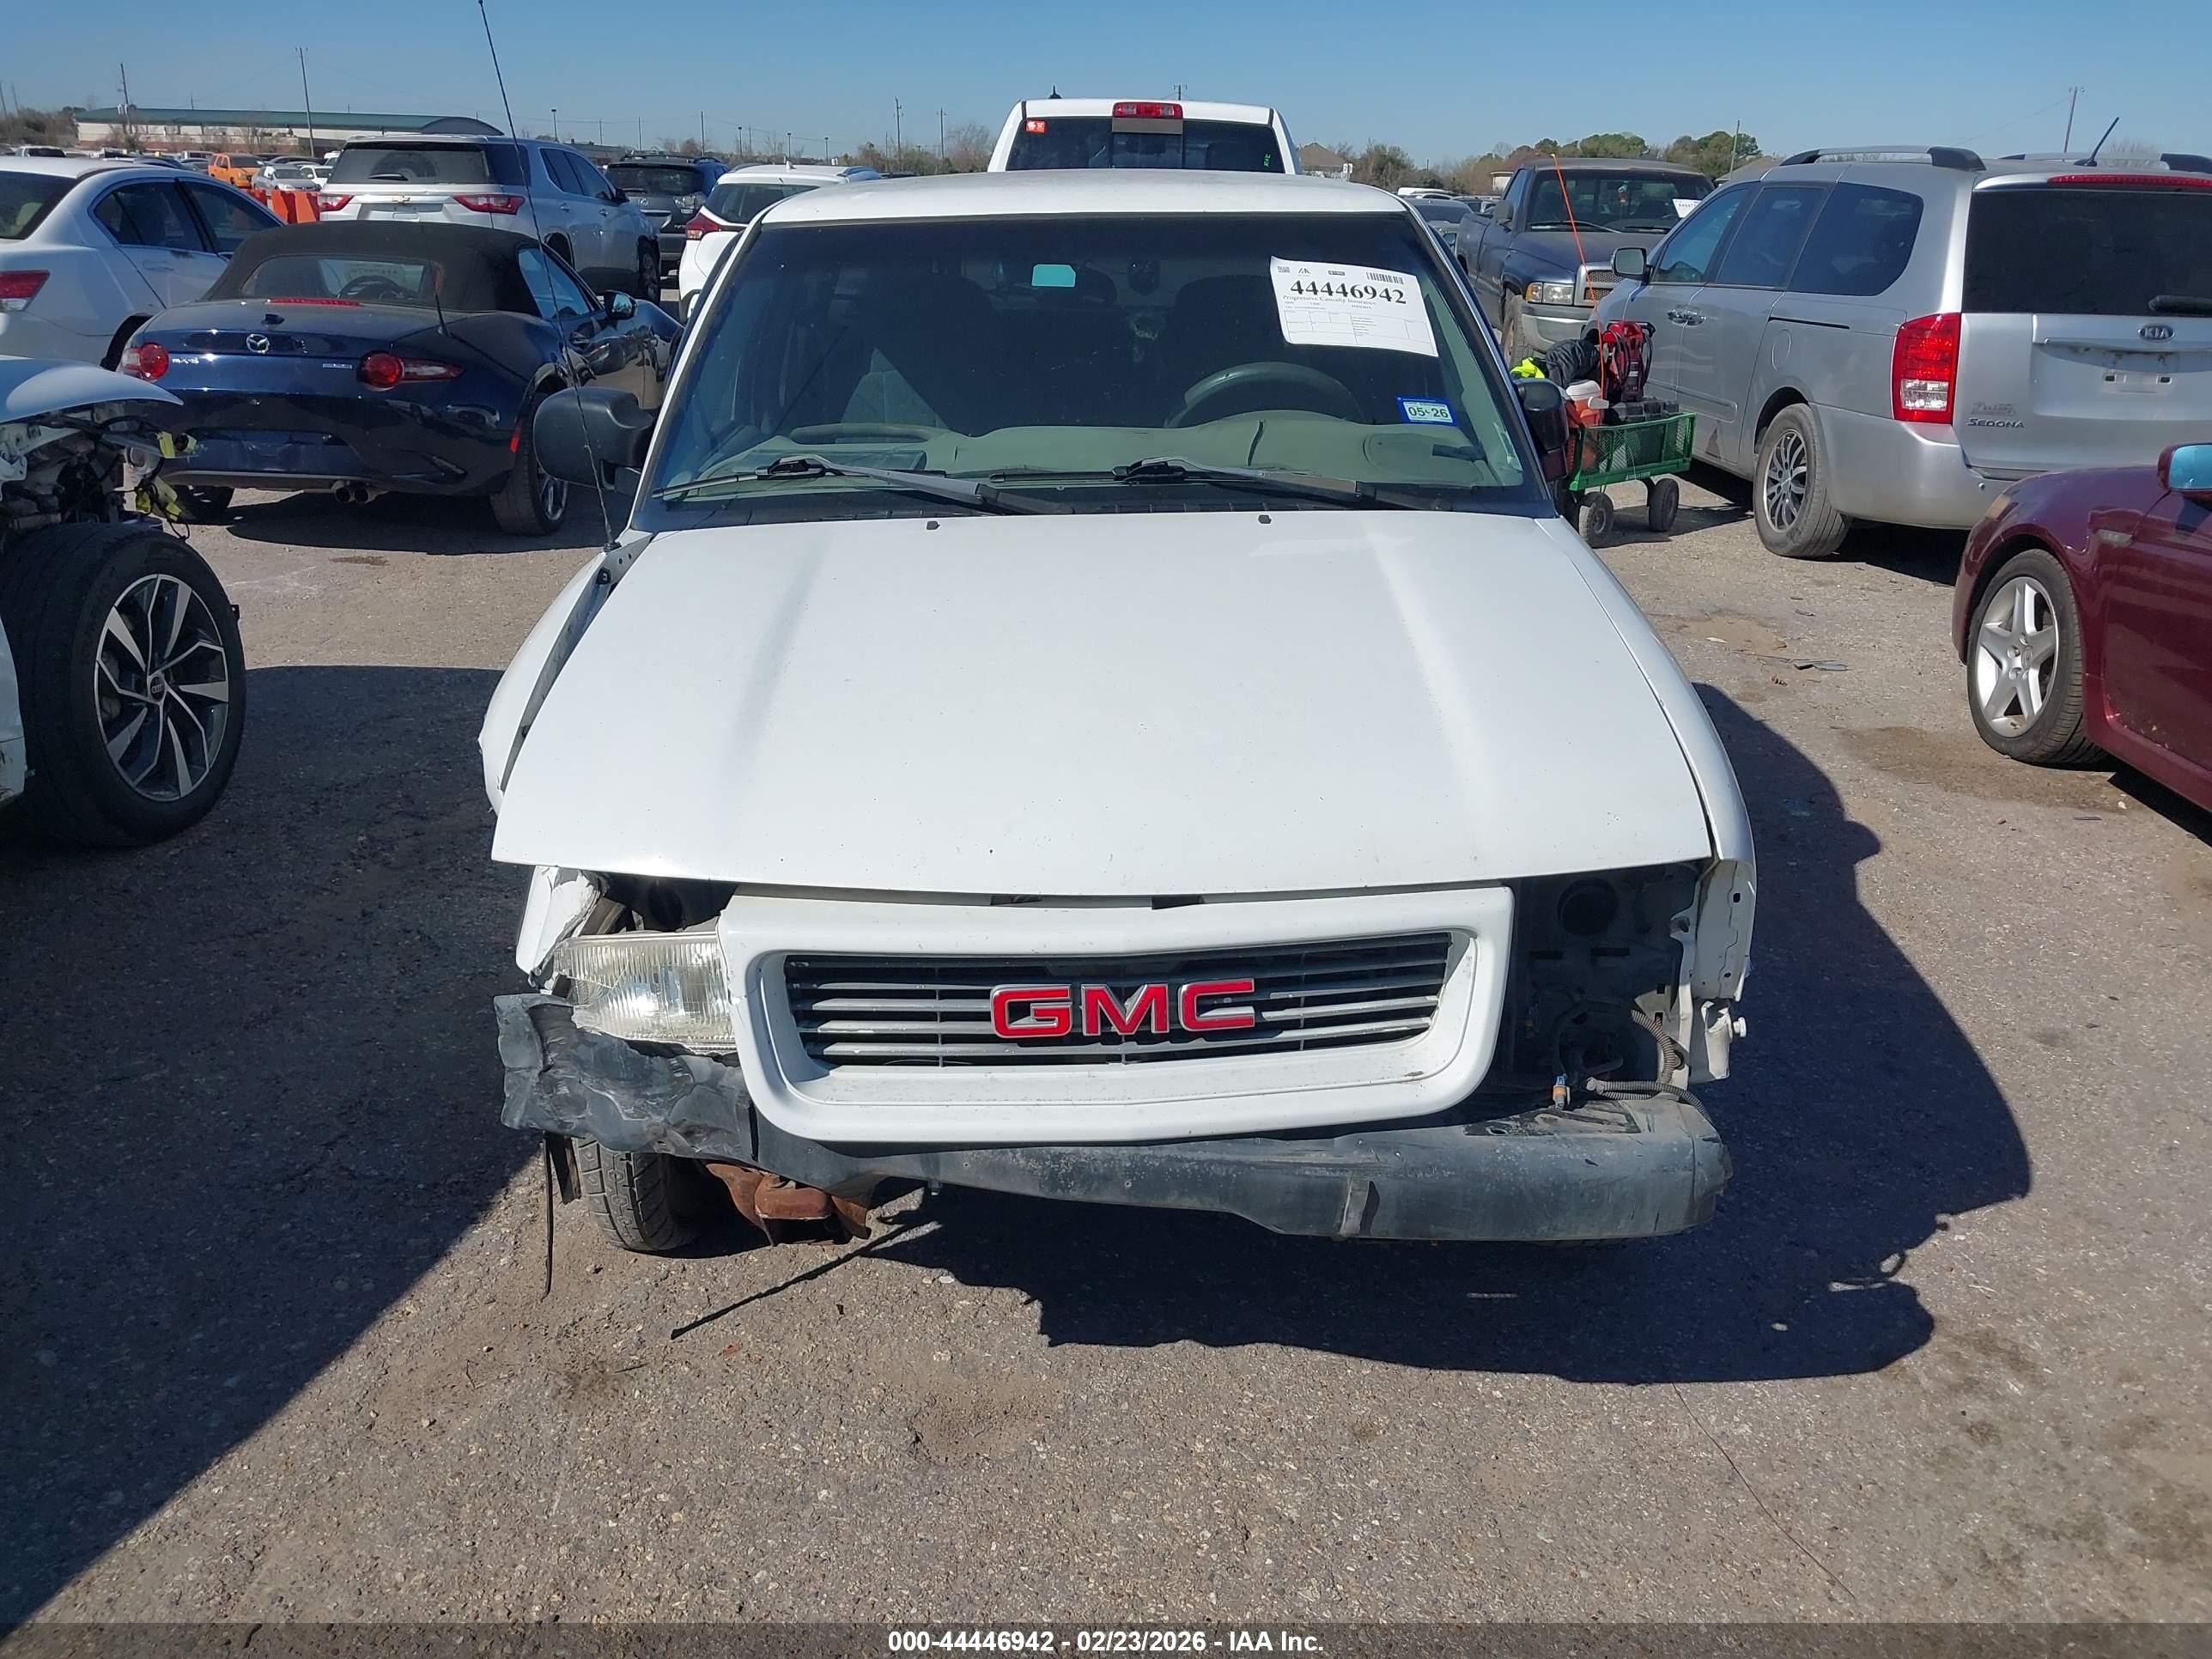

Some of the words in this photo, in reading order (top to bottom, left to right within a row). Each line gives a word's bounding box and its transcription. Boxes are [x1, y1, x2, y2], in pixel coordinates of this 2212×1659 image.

[1291, 280, 1407, 304] 44446942
[2144, 327, 2170, 337] KIA
[1966, 416, 2025, 428] SEDONA
[990, 978, 1255, 1039] GMC
